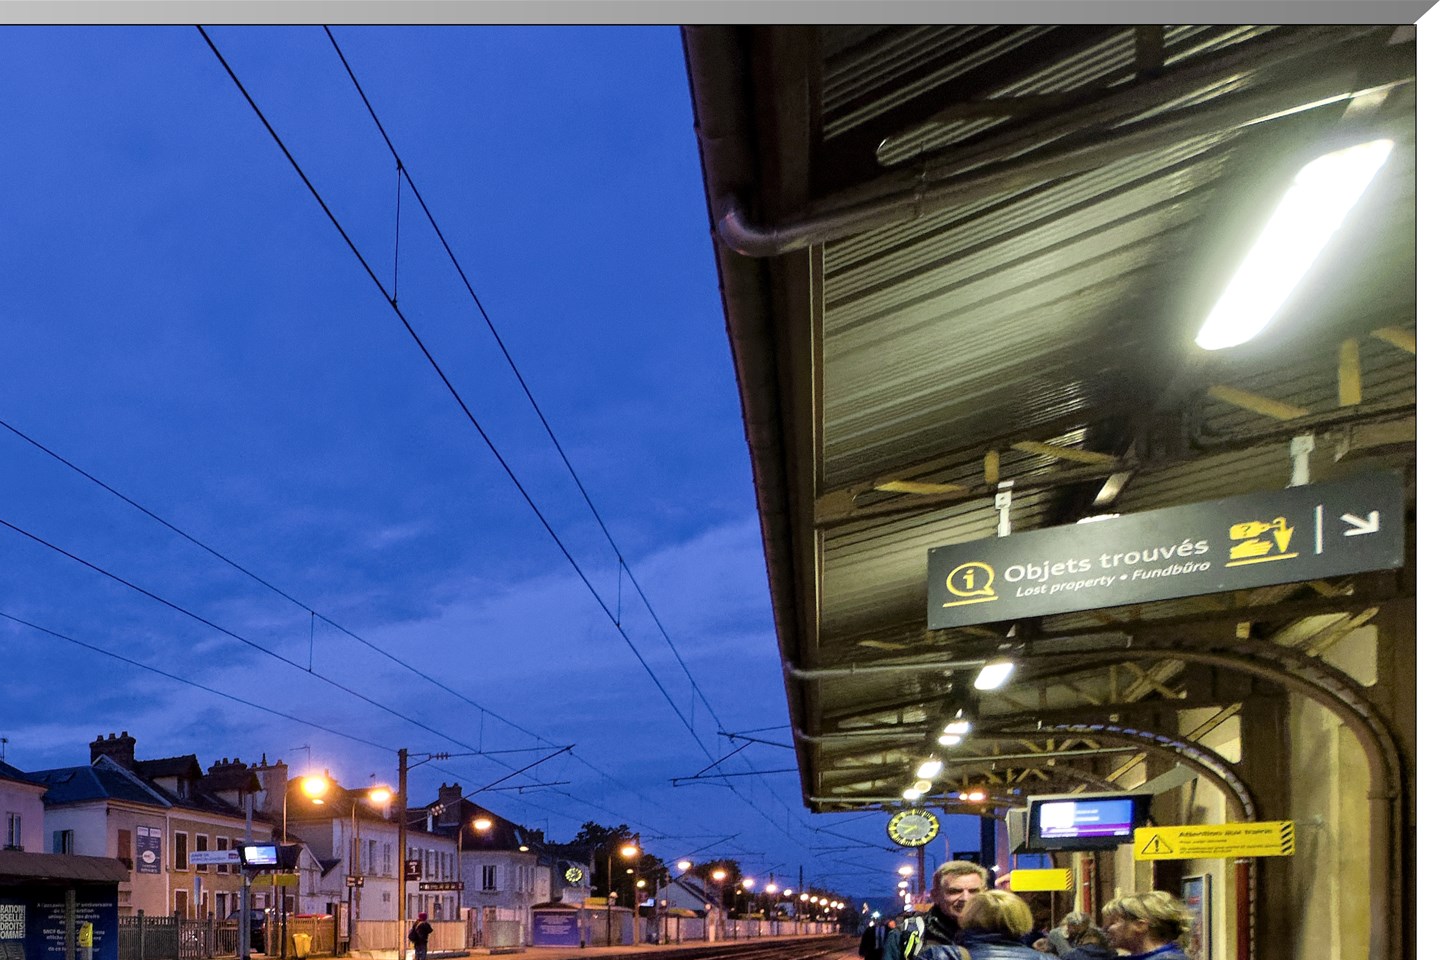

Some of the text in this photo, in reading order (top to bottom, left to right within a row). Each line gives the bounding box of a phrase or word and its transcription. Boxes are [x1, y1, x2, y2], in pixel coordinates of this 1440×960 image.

[1003, 537, 1210, 583] Objets trouvés
[1016, 560, 1211, 598] Lost property Fundbüro
[0, 922, 23, 931] DROITS
